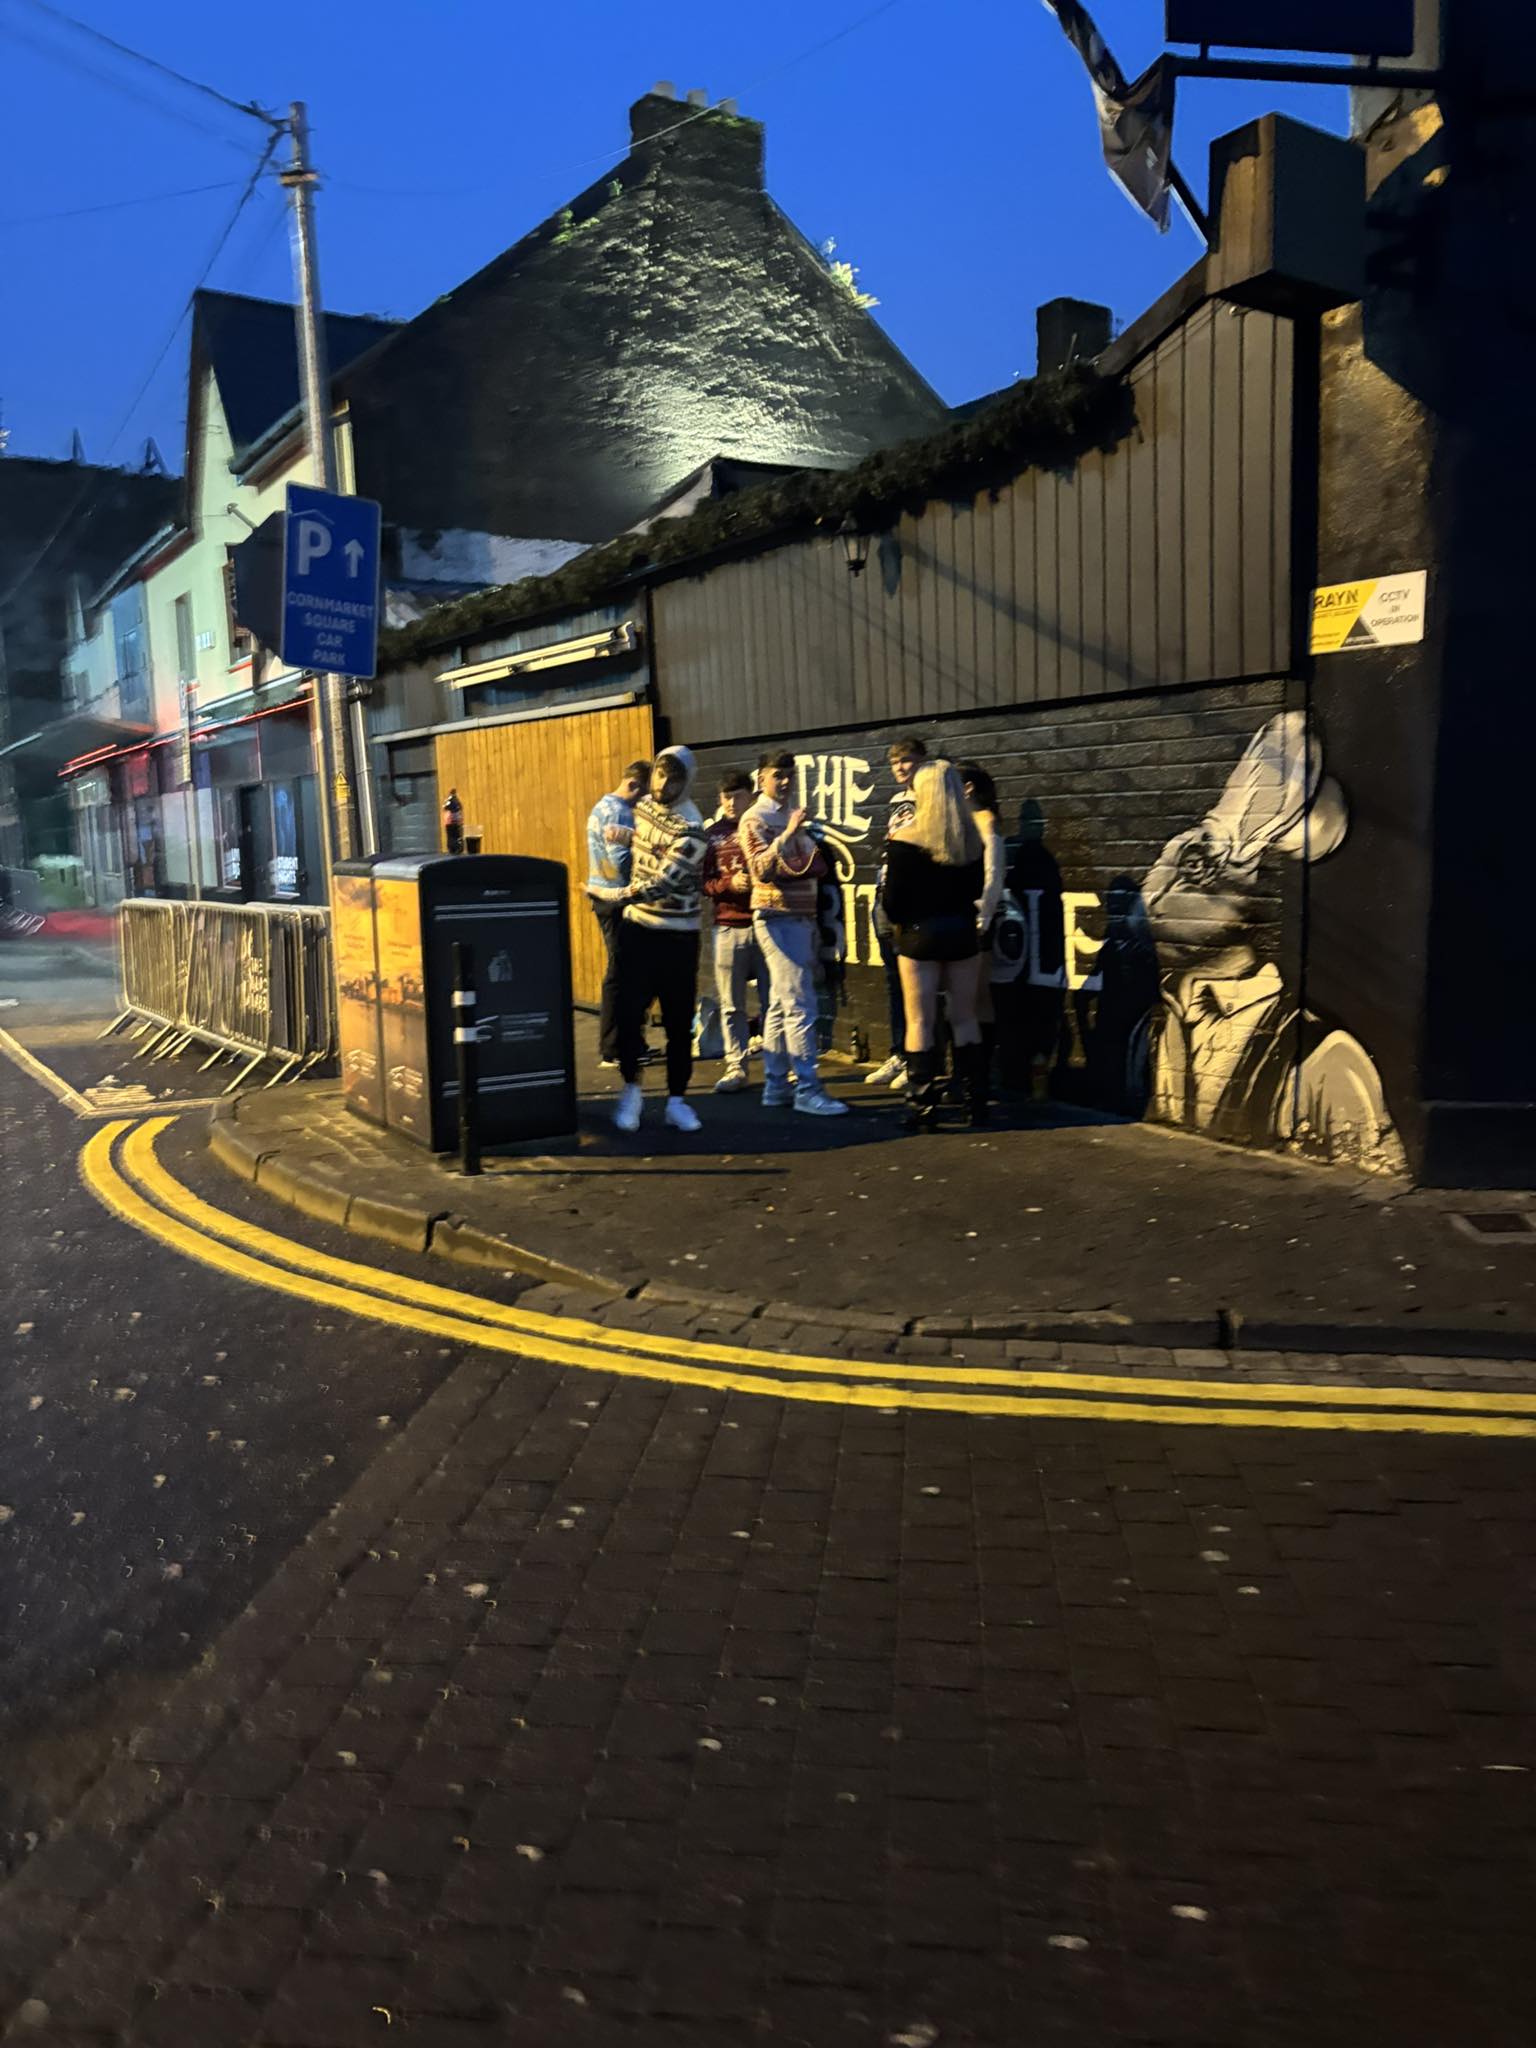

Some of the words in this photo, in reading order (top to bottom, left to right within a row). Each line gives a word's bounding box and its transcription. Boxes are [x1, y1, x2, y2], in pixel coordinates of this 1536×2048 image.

[298, 519, 332, 575] P
[1380, 589, 1411, 602] CCTV
[287, 592, 373, 618] CORNMARKET
[304, 613, 355, 633] SQUARE
[1370, 614, 1419, 627] OPERATION
[317, 632, 342, 648] CAR
[313, 649, 345, 665] PARK
[794, 755, 874, 831] THE
